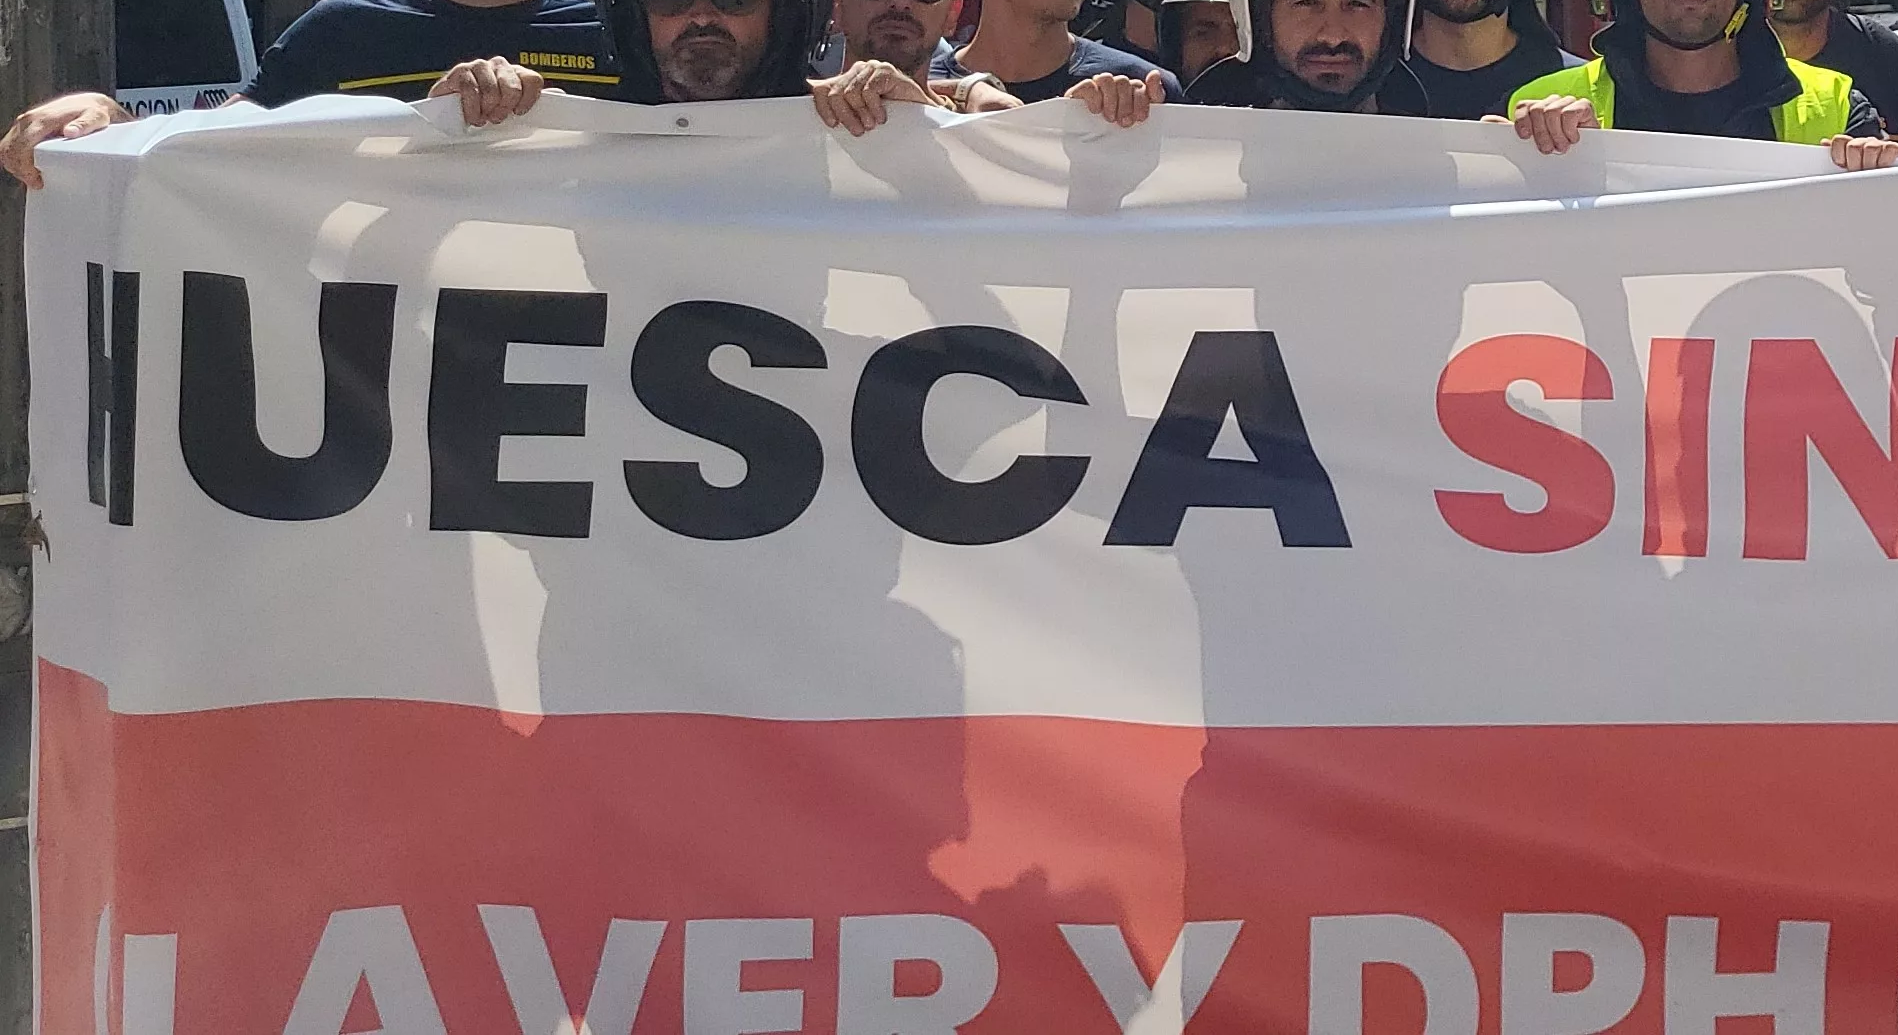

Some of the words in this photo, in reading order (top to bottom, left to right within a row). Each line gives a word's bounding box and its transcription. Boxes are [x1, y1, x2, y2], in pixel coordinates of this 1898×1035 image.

[519, 51, 596, 69] BOMBEROS
[86, 261, 1353, 548] HUESCA
[93, 902, 999, 1035] LAVER
[1056, 919, 1245, 1035] Y
[1308, 911, 1831, 1035] DPH
